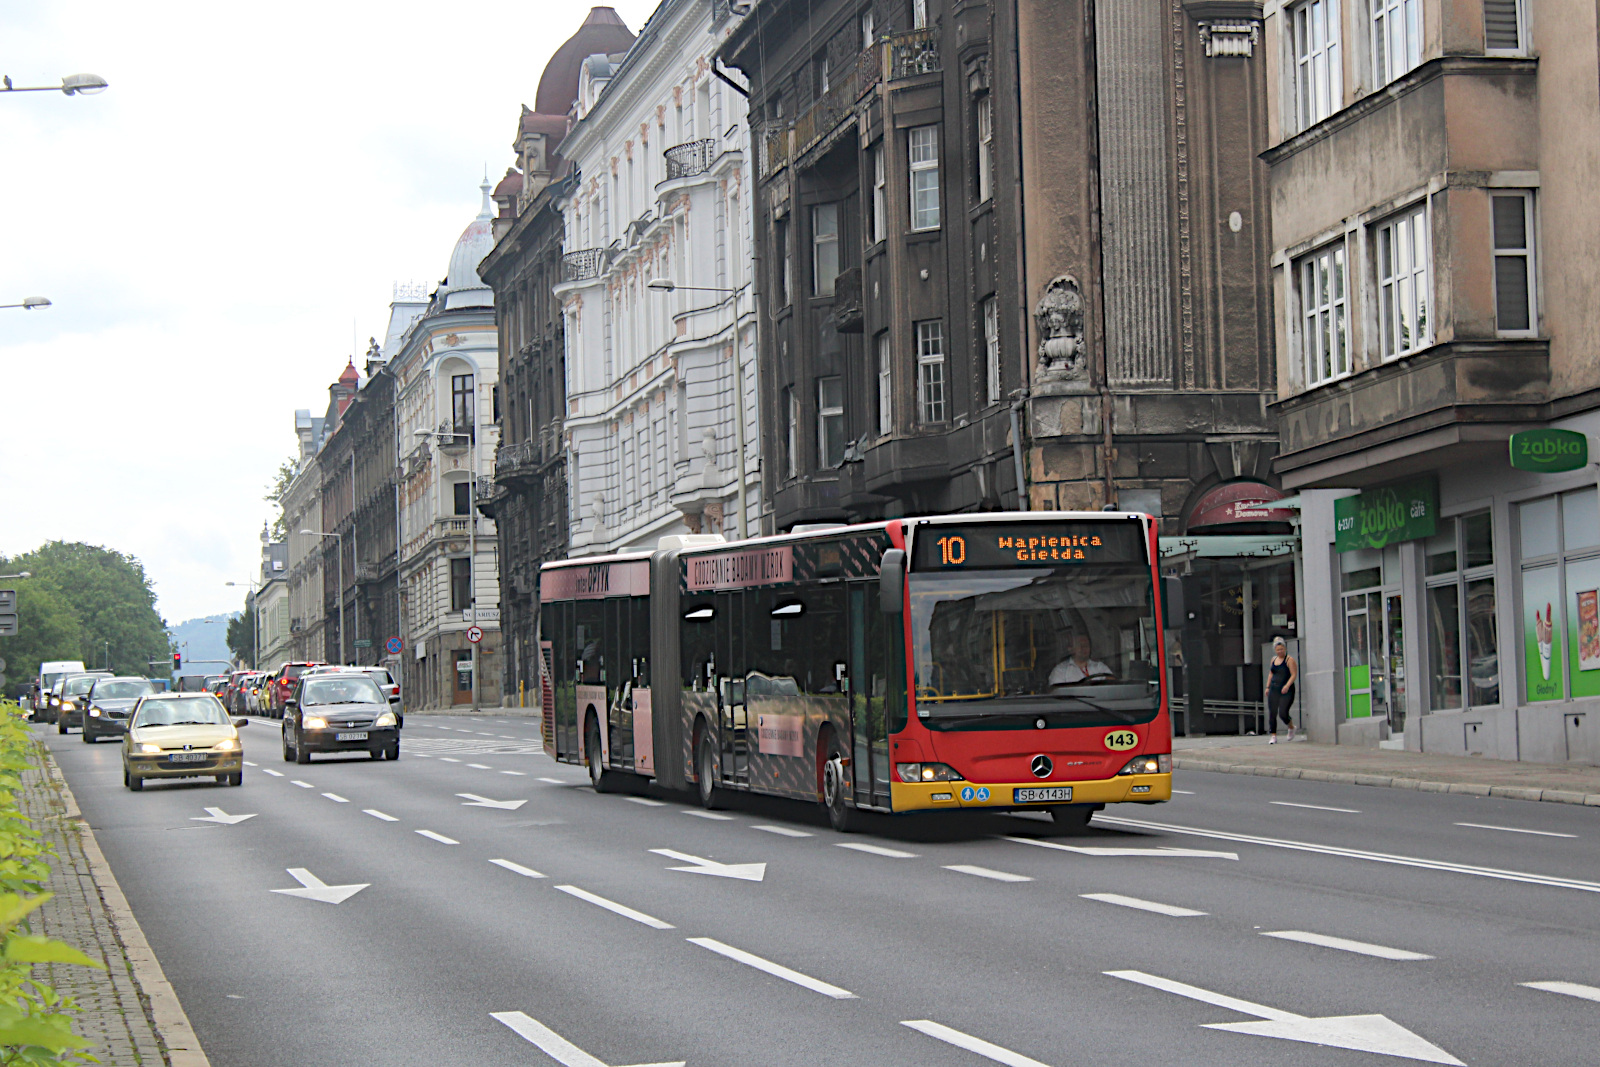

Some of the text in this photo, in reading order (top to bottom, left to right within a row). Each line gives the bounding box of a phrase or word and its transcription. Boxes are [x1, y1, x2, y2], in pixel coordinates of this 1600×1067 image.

[1521, 438, 1581, 455] żabka
[1338, 517, 1354, 531] 6-23/7
[1361, 496, 1405, 536] żabka
[937, 536, 965, 564] 10
[998, 535, 1102, 549] Wapienica
[695, 558, 730, 586] CODZIENNIE
[1107, 733, 1135, 748] 143
[1020, 789, 1071, 800] SB 6143H
